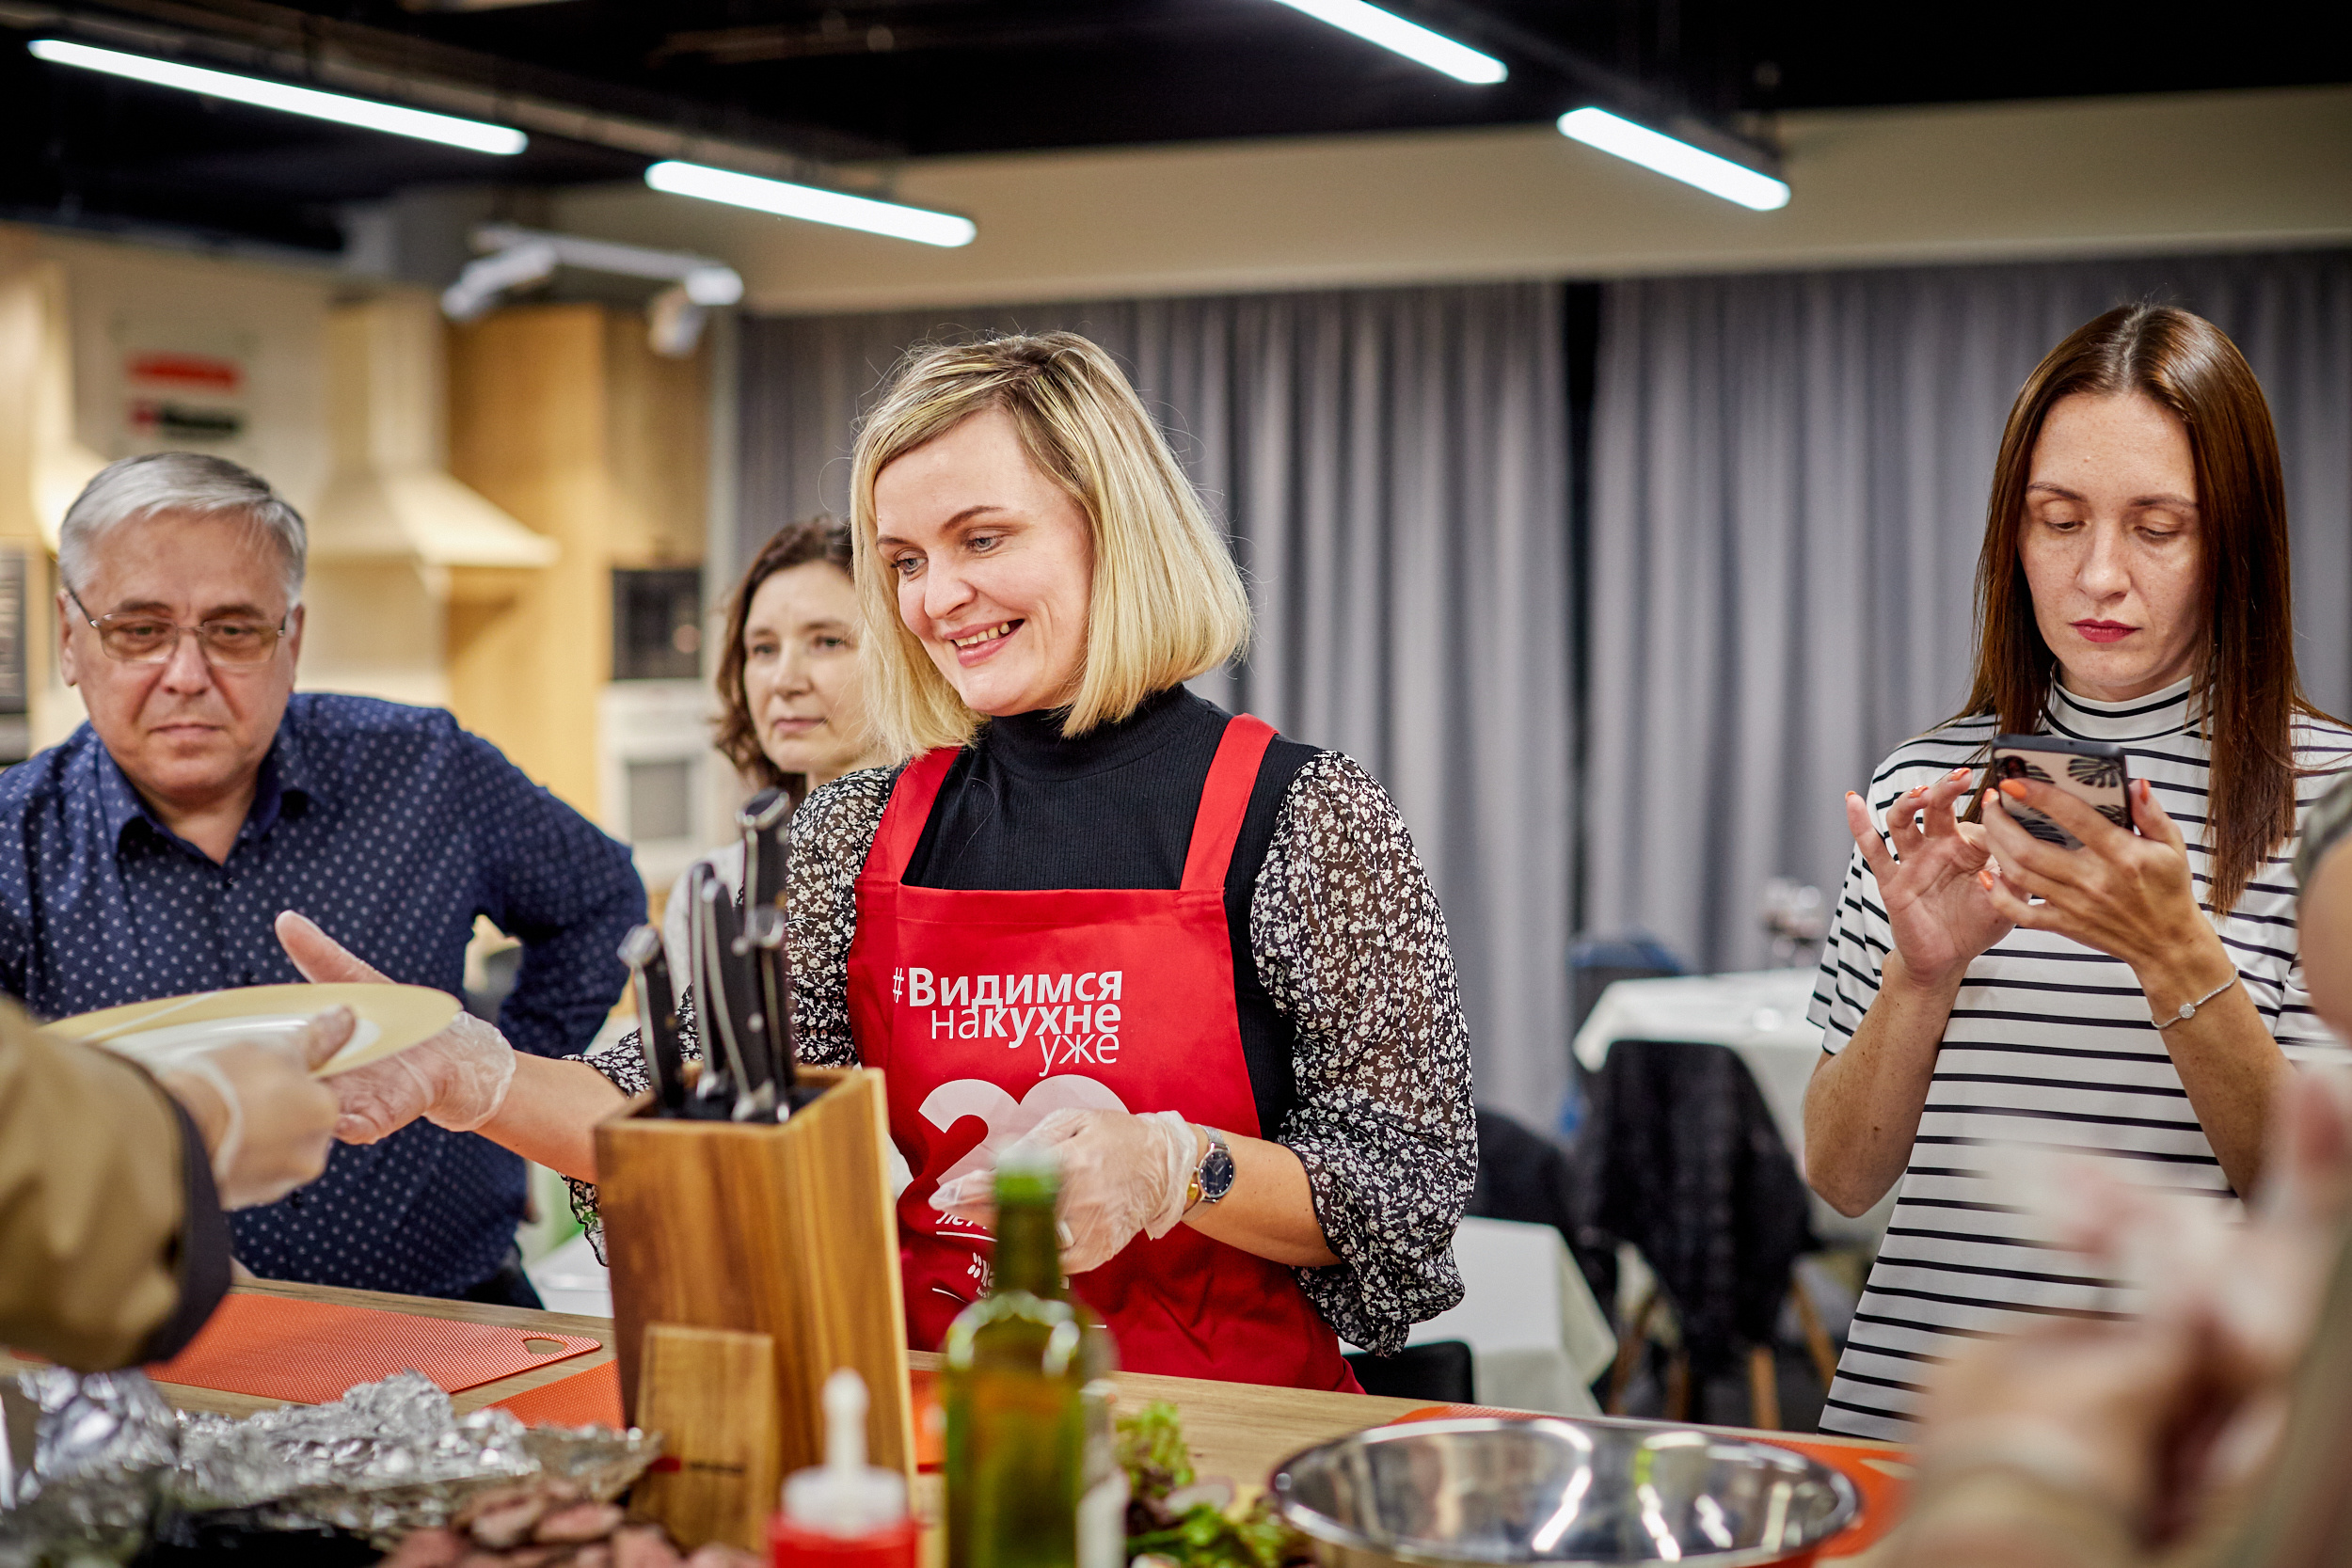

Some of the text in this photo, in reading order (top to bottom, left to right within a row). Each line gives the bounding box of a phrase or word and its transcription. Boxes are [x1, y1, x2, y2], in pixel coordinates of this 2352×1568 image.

[892, 966, 1122, 1012] #Видимся
[930, 1003, 1121, 1049] накухне
[1039, 1032, 1120, 1077] уже
